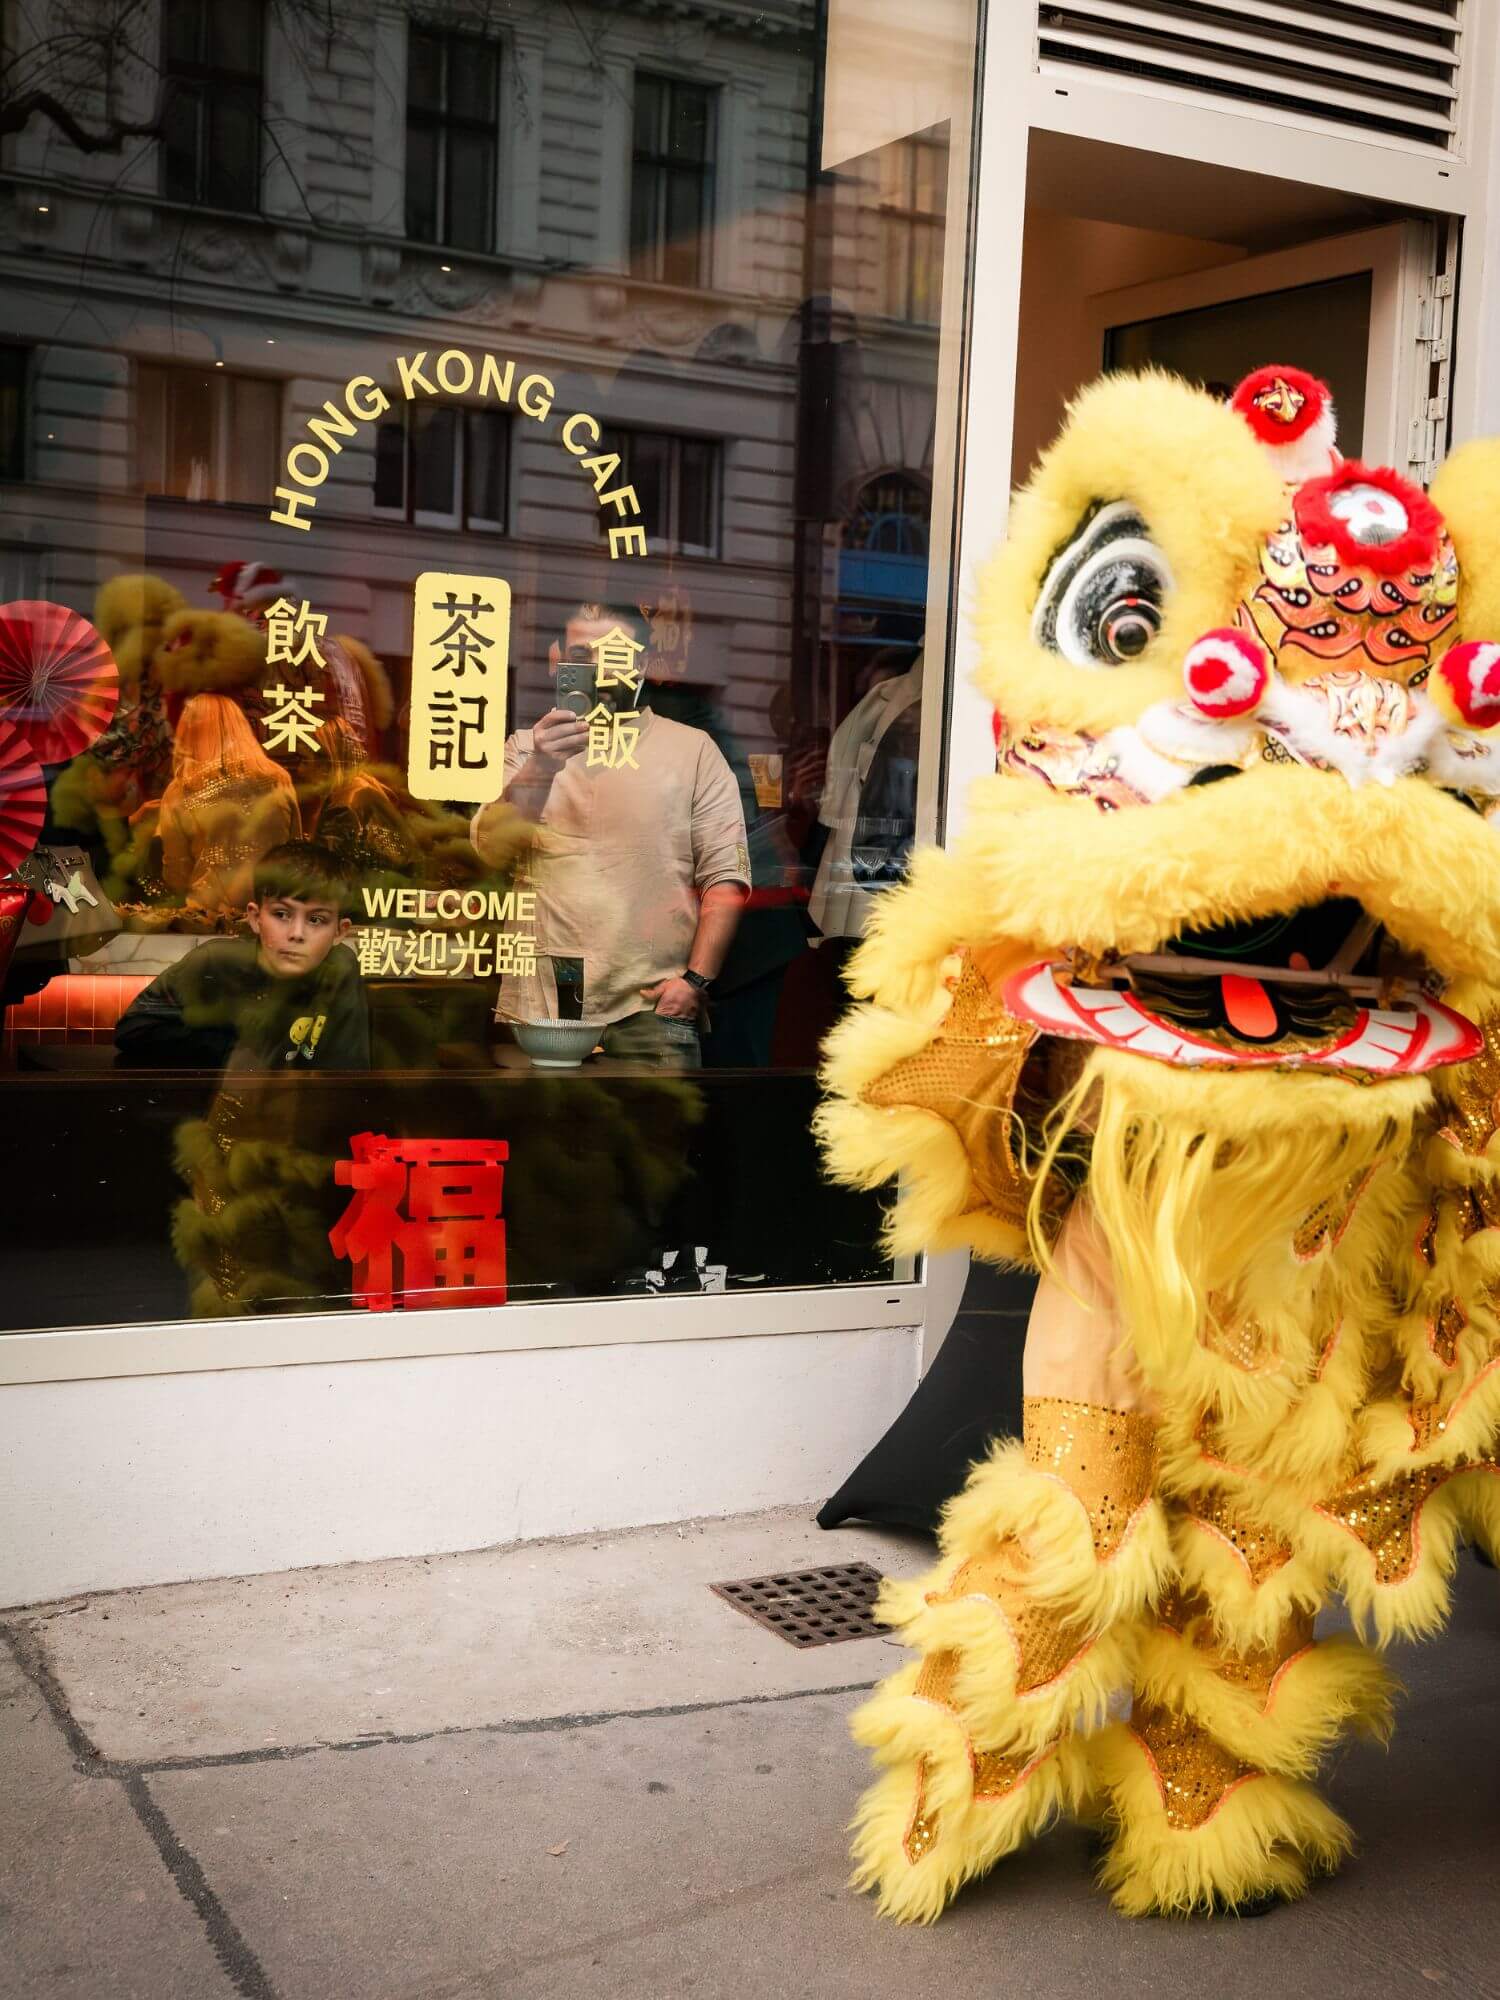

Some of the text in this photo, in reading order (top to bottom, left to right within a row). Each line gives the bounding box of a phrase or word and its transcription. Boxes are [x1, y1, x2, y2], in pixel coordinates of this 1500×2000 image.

[270, 349, 649, 560] HONG KONG CAFE
[260, 597, 329, 753] 飲茶
[428, 591, 497, 771] 茶記
[584, 626, 646, 771] 食飯
[357, 928, 538, 978] 歡迎光臨
[362, 887, 538, 922] WELCOME
[329, 1131, 510, 1312] 福
